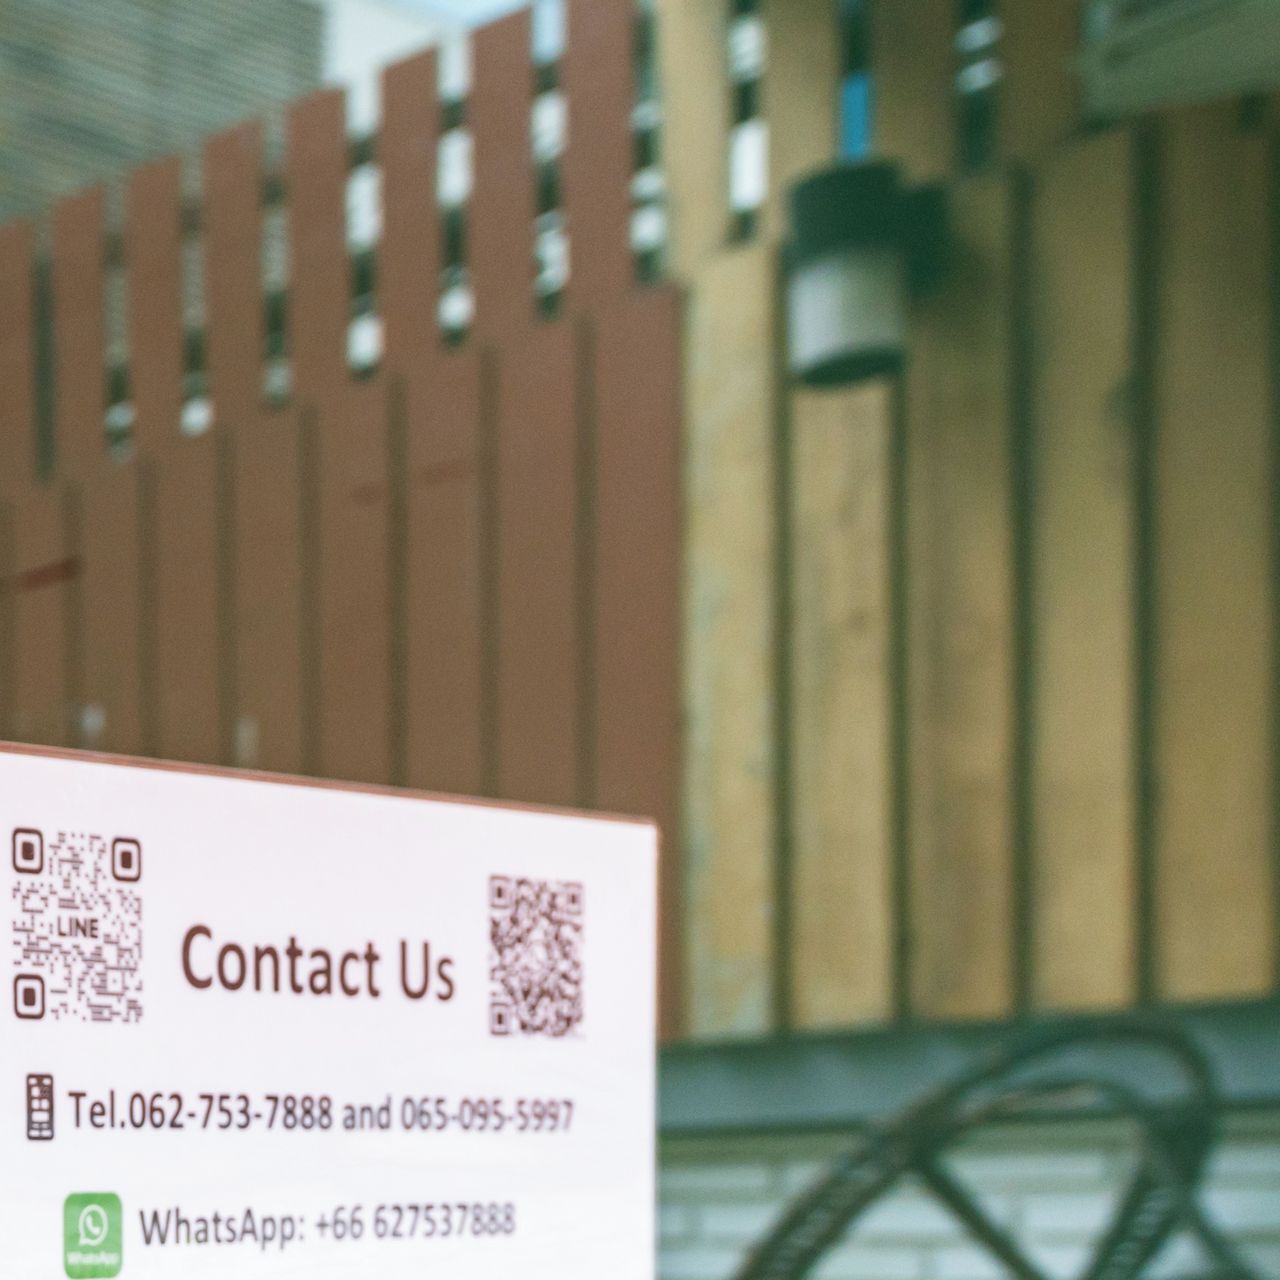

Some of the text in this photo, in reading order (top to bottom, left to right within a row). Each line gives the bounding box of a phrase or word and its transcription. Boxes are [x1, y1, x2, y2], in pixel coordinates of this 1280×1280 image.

[57, 917, 99, 939] LINE
[181, 925, 454, 1001] Contact Us
[68, 1090, 574, 1132] Tel.062-753-7888 and 065-095-5997
[139, 1203, 514, 1250] WhatsApp: +66 627537888
